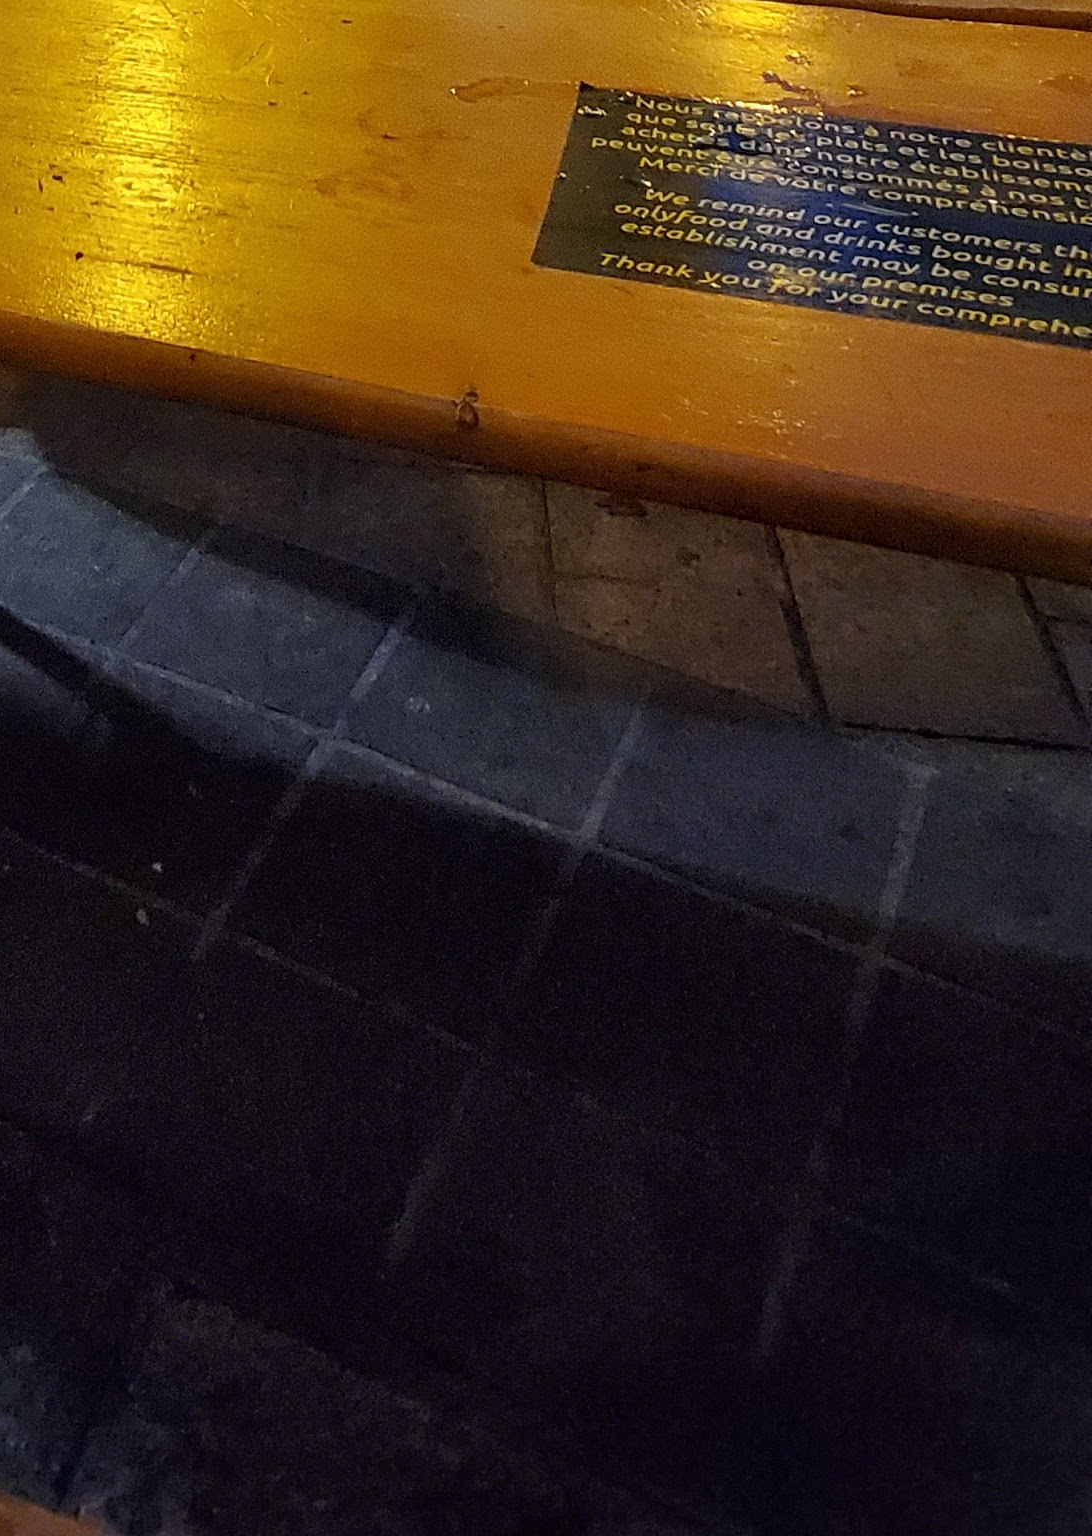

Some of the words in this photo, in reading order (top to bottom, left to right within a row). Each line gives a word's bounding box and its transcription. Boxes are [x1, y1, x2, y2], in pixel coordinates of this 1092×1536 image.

[626, 111, 677, 127] que
[816, 135, 889, 153] plats
[897, 145, 930, 159] et
[939, 147, 983, 164] les
[636, 95, 705, 116] Nous
[864, 125, 879, 137] à
[889, 130, 973, 149] notre
[591, 136, 710, 161] peuvent
[787, 161, 970, 195] consommés
[980, 184, 997, 198] à
[1008, 189, 1066, 206] nos
[639, 156, 723, 178] Merci
[729, 168, 766, 184] de
[774, 175, 857, 196] votre
[739, 139, 810, 158] dans
[817, 150, 901, 169] notre
[645, 188, 690, 206] We
[698, 197, 806, 222] remind
[813, 214, 868, 229] our
[874, 222, 1044, 255] customers
[619, 221, 843, 264] establishment
[851, 255, 921, 276] may
[930, 262, 973, 282] be
[755, 223, 816, 241] and
[823, 231, 922, 256] drinks
[930, 244, 1053, 274] bought
[599, 253, 696, 279] Thank
[695, 271, 762, 289] you
[768, 276, 822, 298] for
[825, 289, 909, 310] your
[916, 301, 1092, 338] comprehe
[746, 259, 787, 275] on
[797, 266, 857, 283] our
[861, 276, 1015, 307] premises
